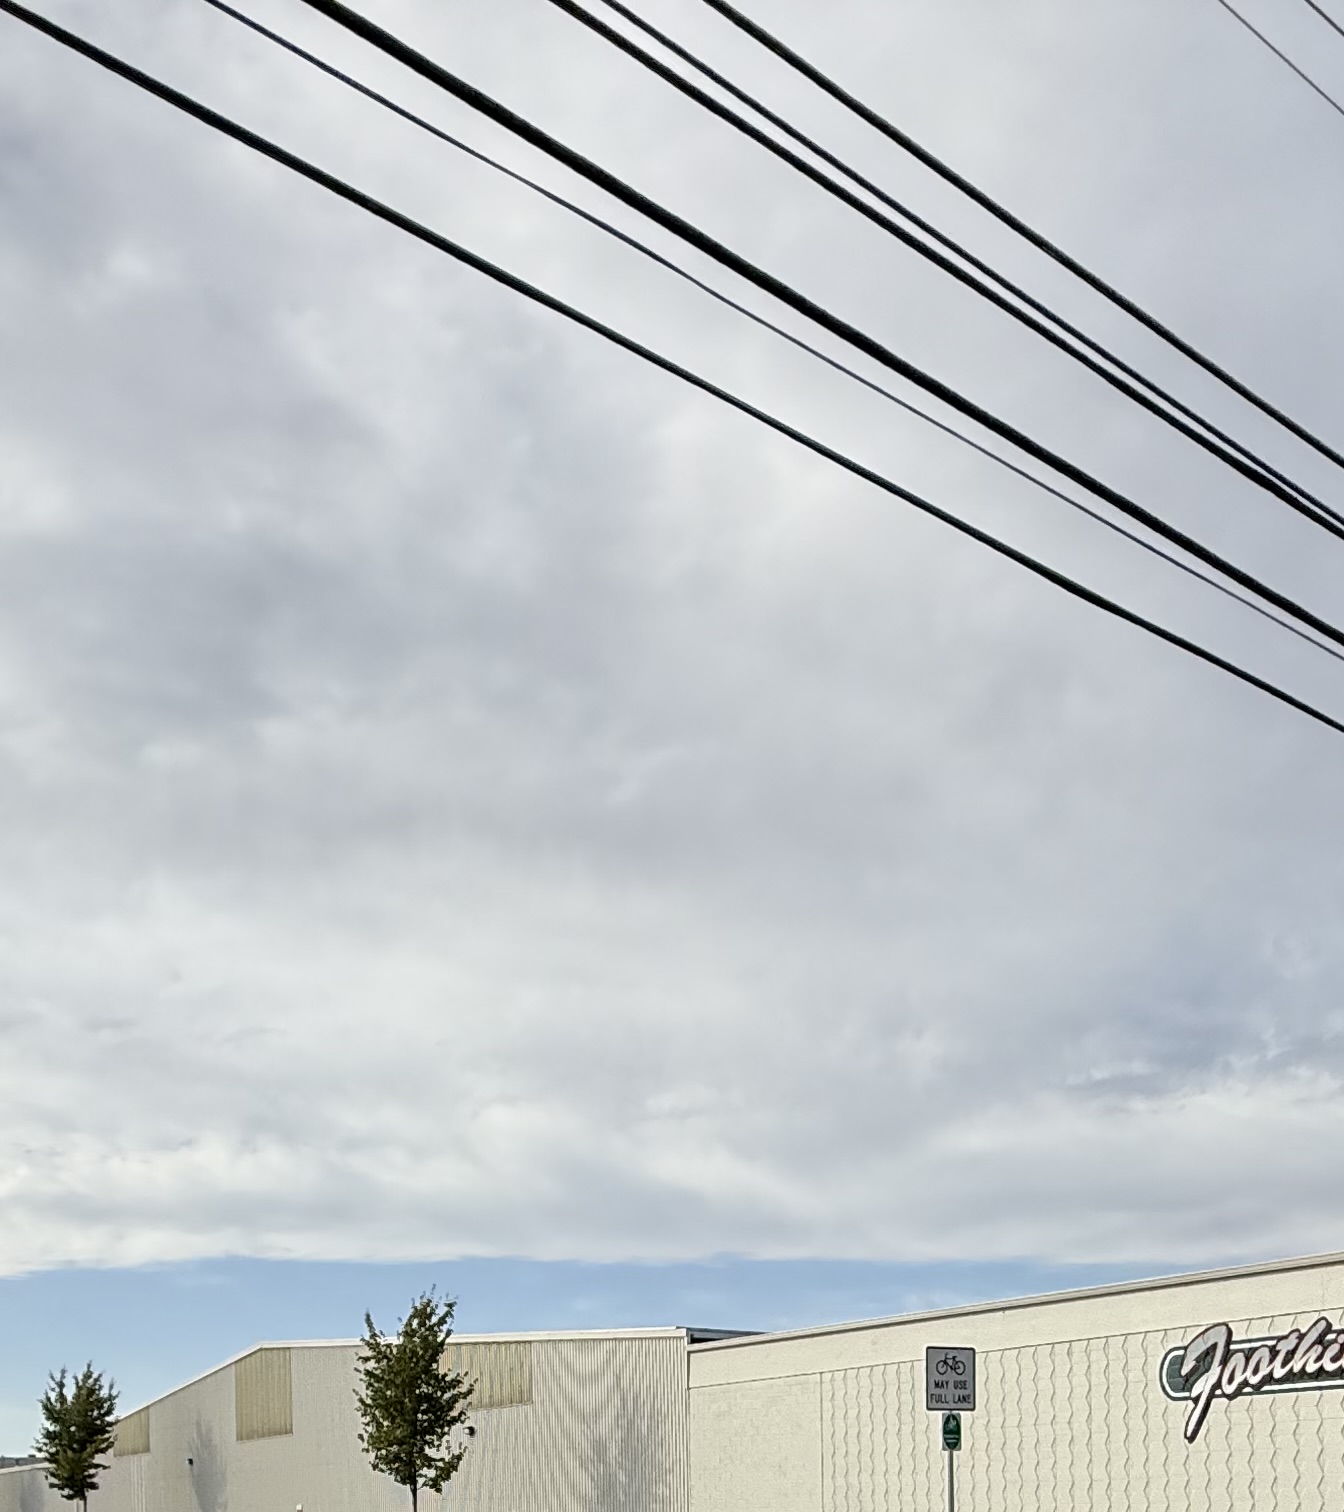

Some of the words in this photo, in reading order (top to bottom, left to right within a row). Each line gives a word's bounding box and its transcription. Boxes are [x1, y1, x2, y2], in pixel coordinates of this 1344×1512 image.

[934, 1380, 949, 1390] MAY
[953, 1380, 968, 1390] USE
[930, 1394, 949, 1404] FULL
[952, 1394, 972, 1404] LANE
